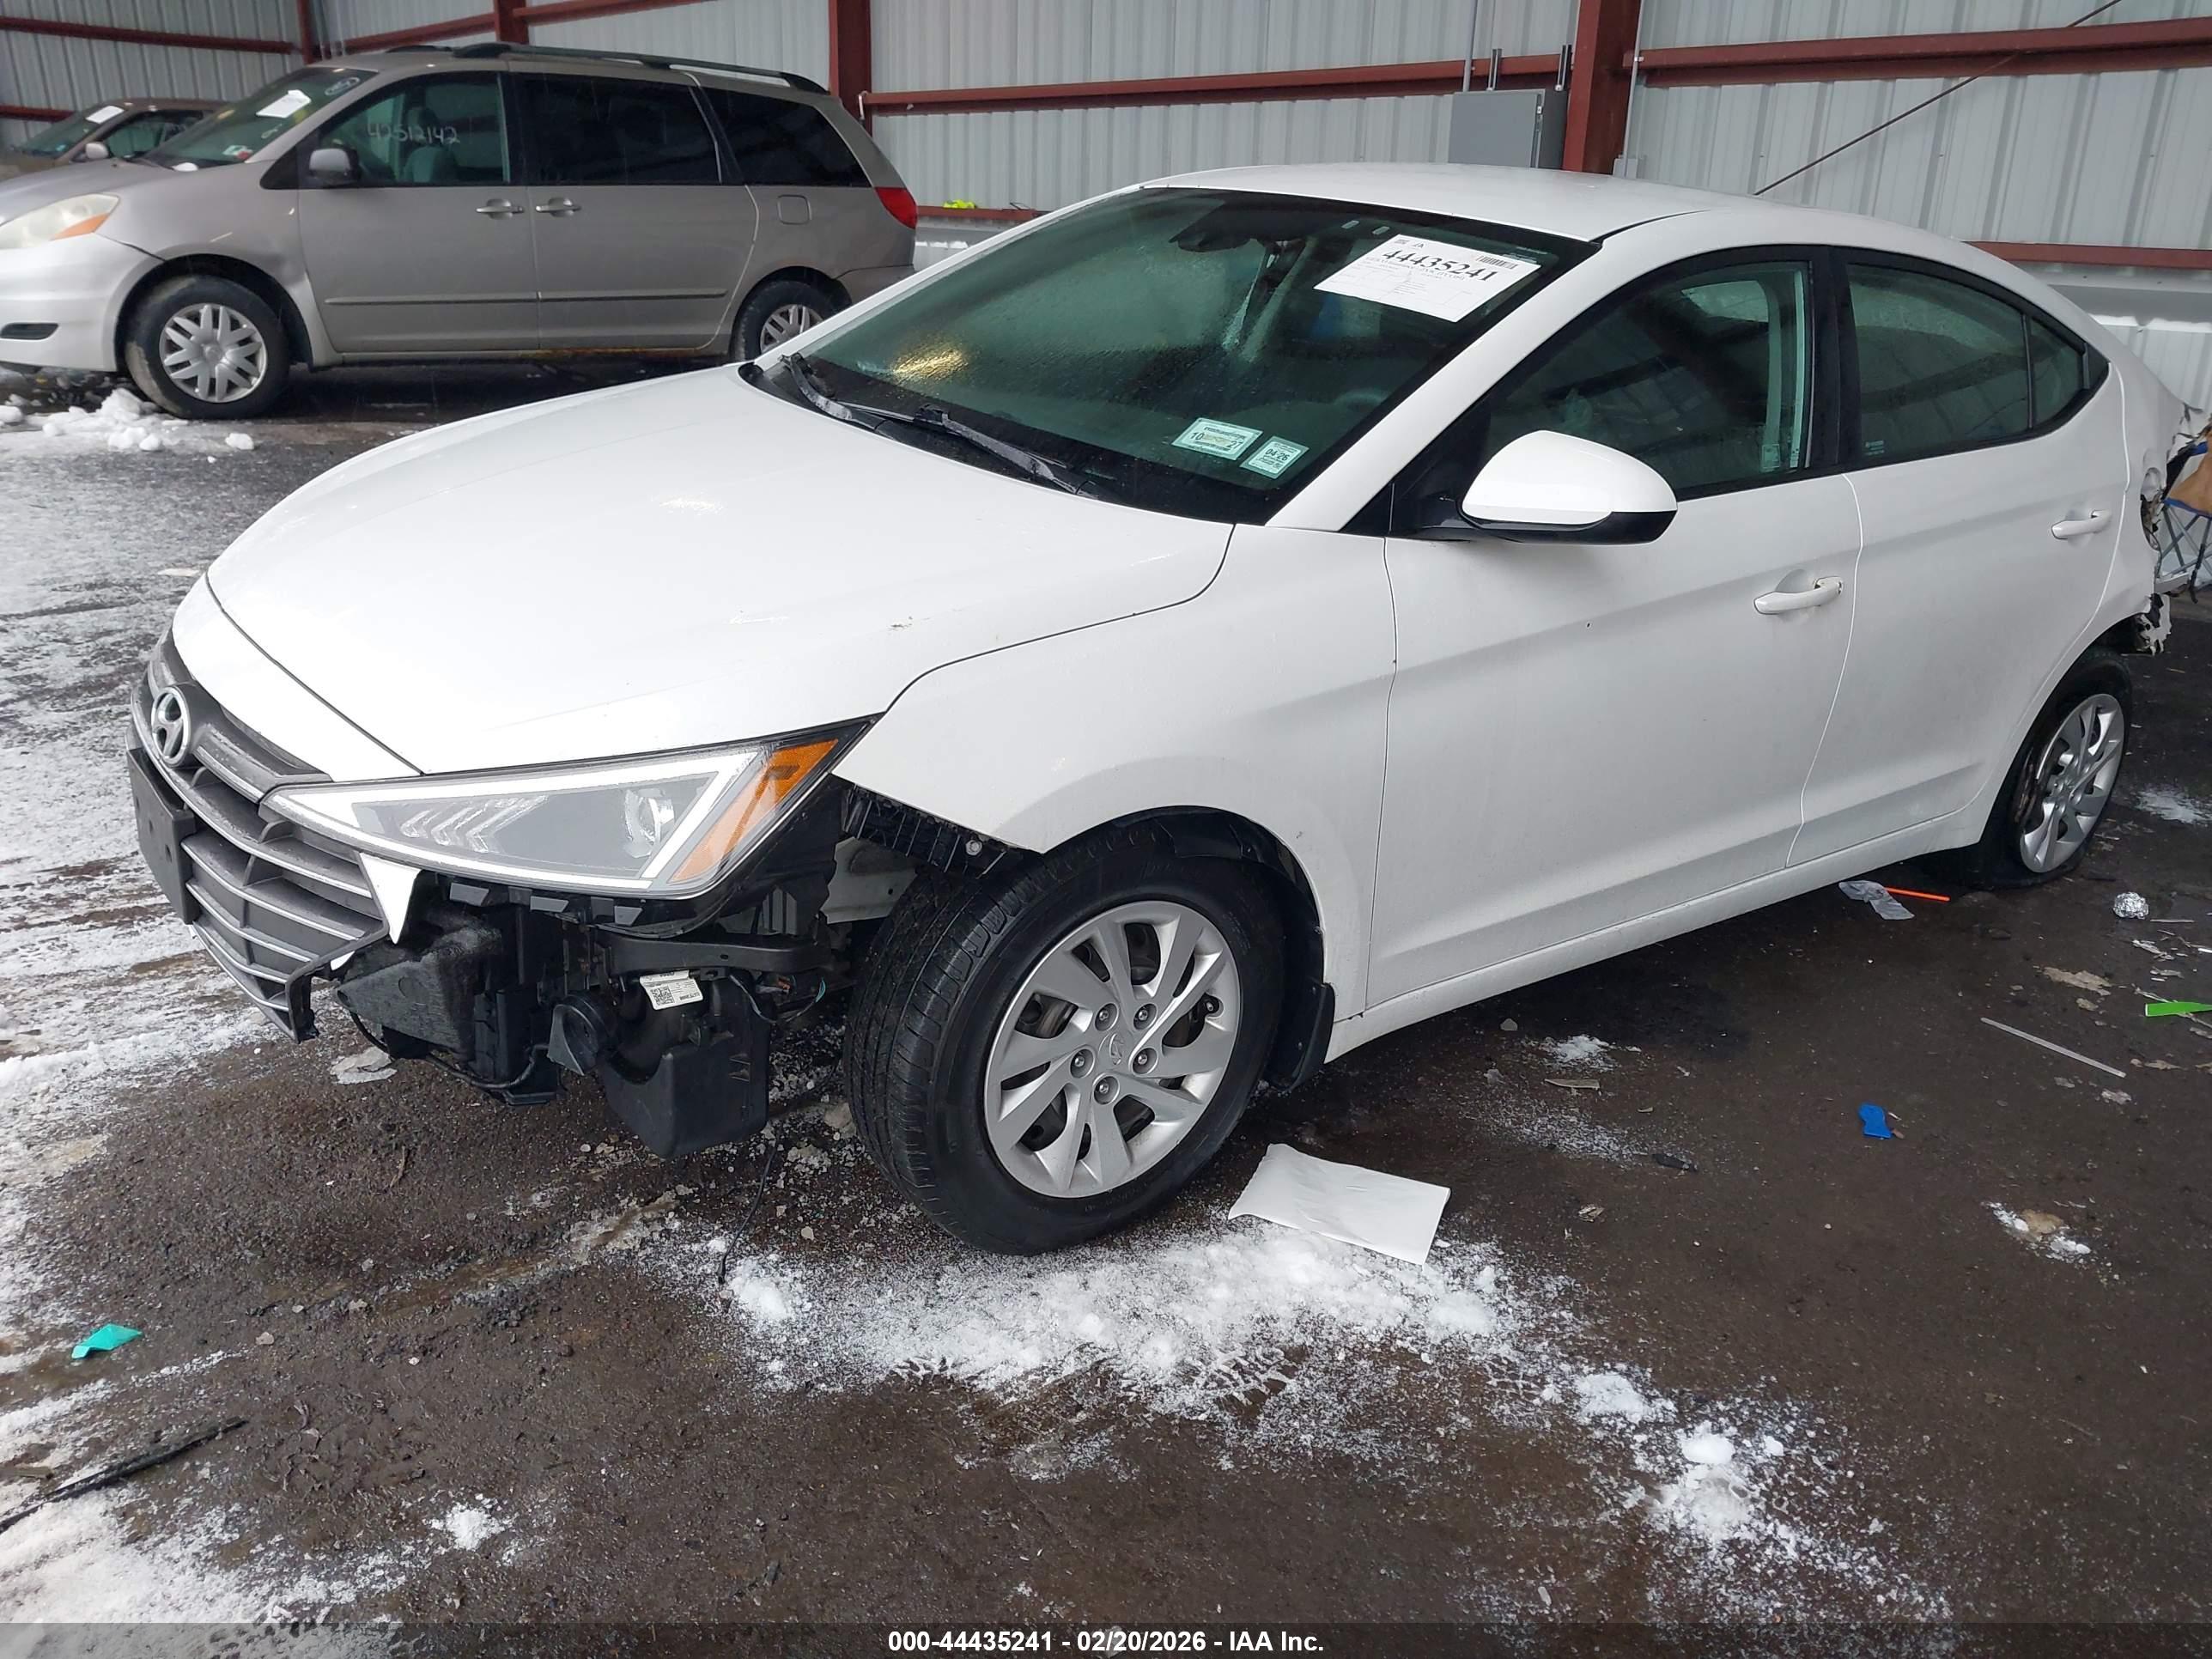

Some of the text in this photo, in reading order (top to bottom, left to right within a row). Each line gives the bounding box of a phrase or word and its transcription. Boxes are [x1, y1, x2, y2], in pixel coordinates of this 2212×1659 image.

[367, 122, 461, 144] 42512142
[1382, 249, 1498, 282] 44435241
[1190, 432, 1205, 441] 10
